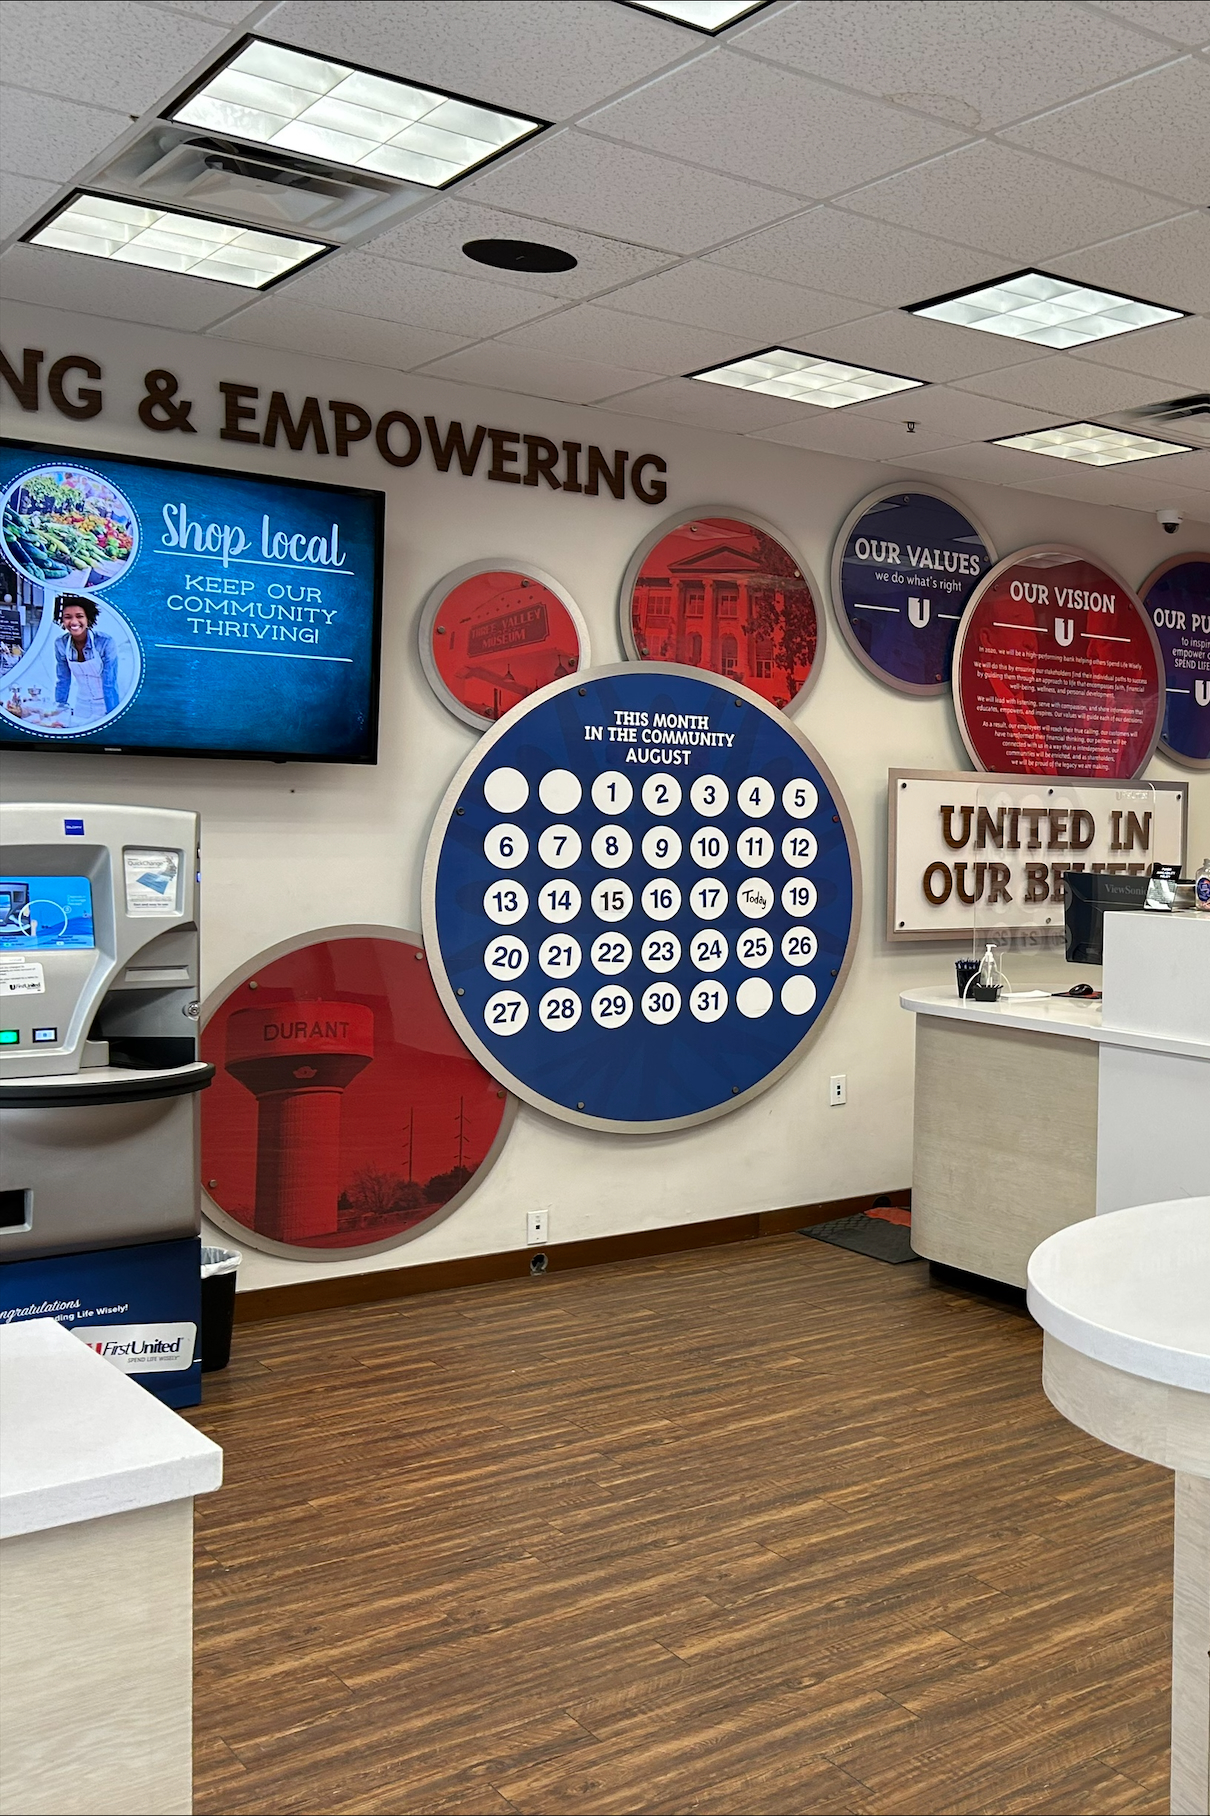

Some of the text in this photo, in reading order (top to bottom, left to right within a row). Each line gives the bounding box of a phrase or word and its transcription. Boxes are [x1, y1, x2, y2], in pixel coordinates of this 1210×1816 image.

[138, 369, 198, 433] &
[219, 381, 668, 505] EMPOWERING
[161, 502, 346, 568] Shop local
[854, 537, 980, 576] OUR VALUES
[184, 574, 322, 603] KEEP OUR
[875, 571, 962, 594] we do what's right
[1010, 580, 1116, 614] OUR VISION
[166, 594, 338, 625] COMMUNITY
[502, 608, 541, 629] VALLEY
[1153, 607, 1187, 631] OUR
[186, 617, 319, 644] THRIVING!
[482, 628, 526, 649] MUSEUM
[1181, 636, 1189, 647] to
[1172, 648, 1206, 661] empower
[1174, 658, 1197, 670] SPEND
[1197, 660, 1210, 672] LIFE
[613, 710, 709, 730] THIS MONTH
[584, 725, 735, 748] IN THE COMMUNITY
[625, 747, 691, 766] AUGUST
[606, 782, 806, 808] 1 2 3 4 5
[940, 805, 1152, 850] UNITED IN
[499, 835, 810, 859] 6 7 8 9 10 11 12
[923, 861, 1013, 905] OUR
[492, 888, 721, 913] 13 14 15 16 17
[741, 889, 767, 910] Today
[789, 887, 810, 906] 19
[491, 936, 812, 970] 20 21 22 23 24 25 26
[492, 991, 719, 1024] 27 28 29 30 31
[263, 1021, 350, 1042] DURANT
[77, 1309, 94, 1319] Life
[96, 1303, 129, 1316] Wisely!
